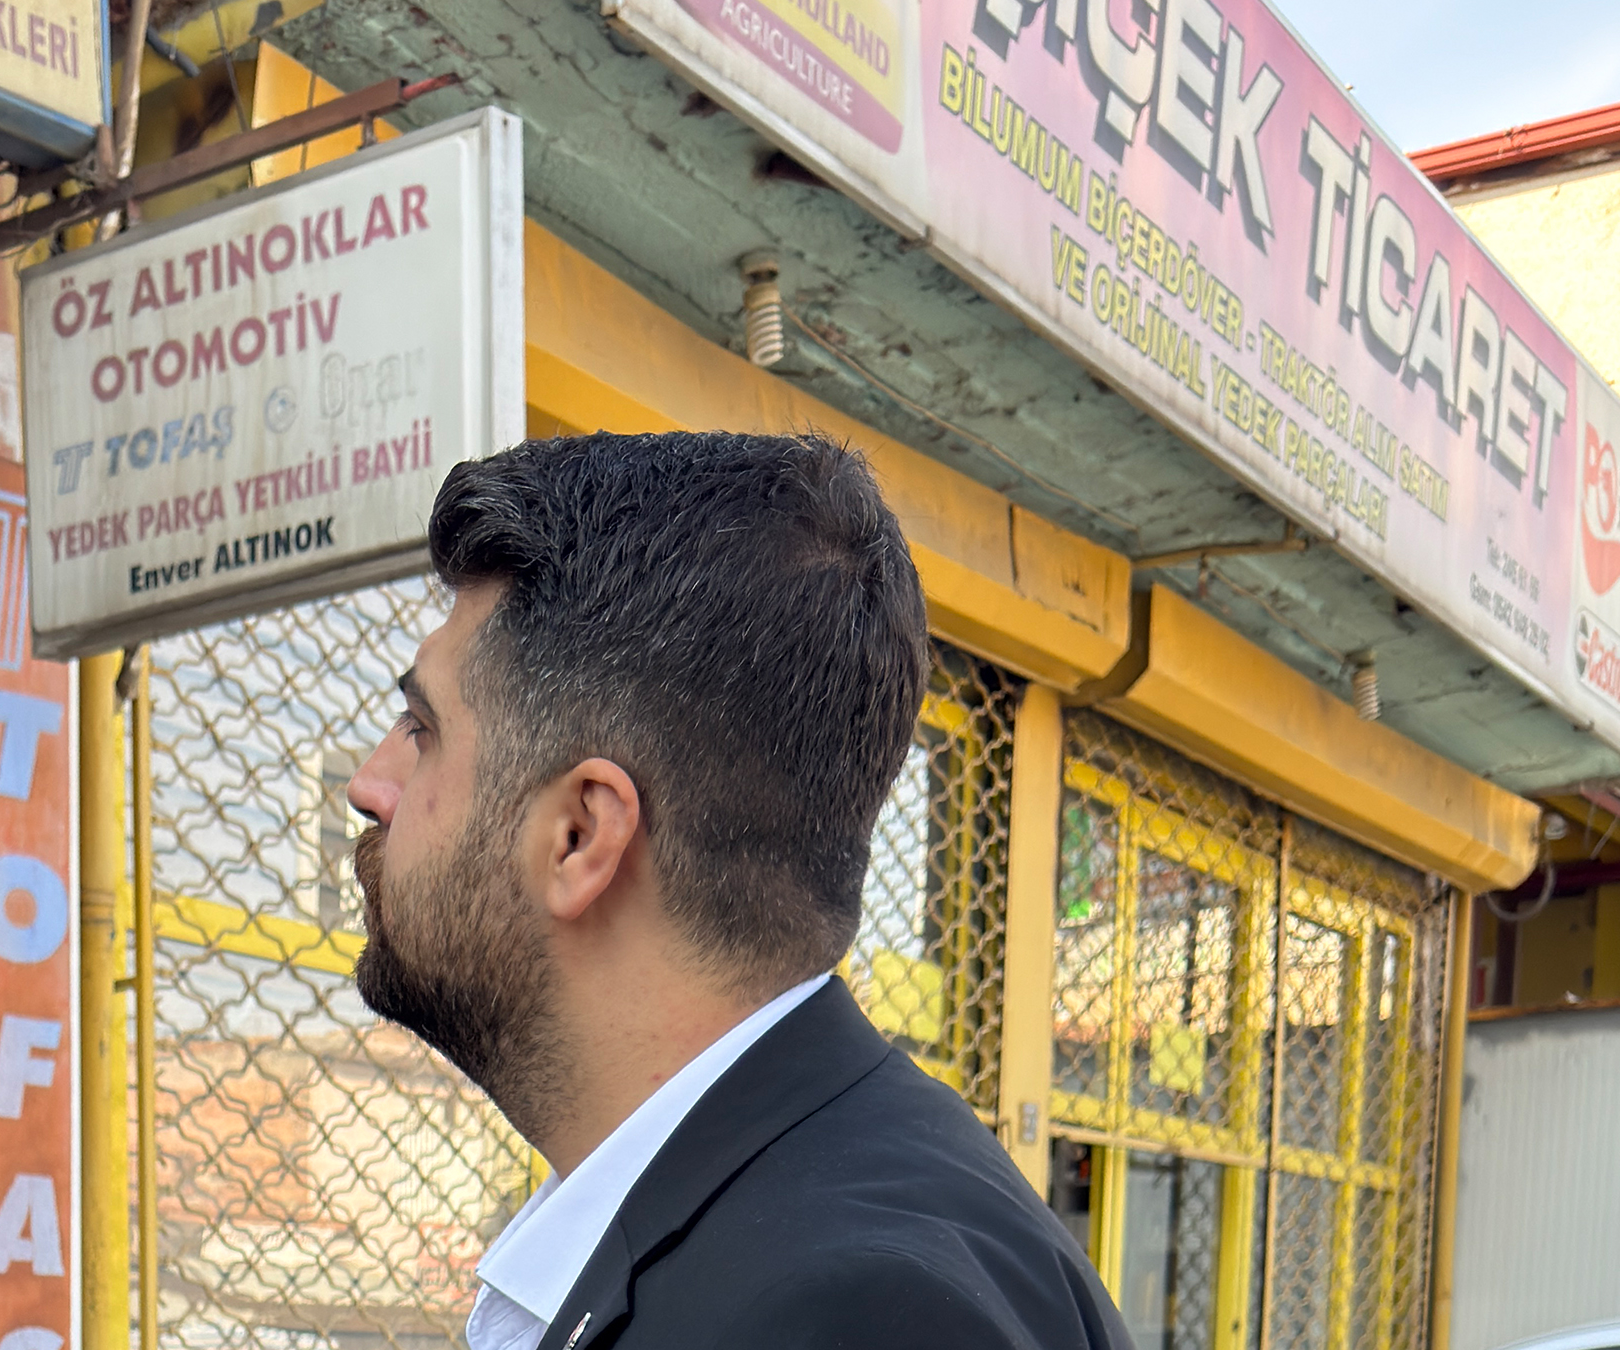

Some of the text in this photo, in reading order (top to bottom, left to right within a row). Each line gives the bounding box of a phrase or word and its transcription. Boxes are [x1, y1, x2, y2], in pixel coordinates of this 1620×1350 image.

[720, 1, 854, 115] AGRICULTURE
[52, 184, 430, 339] ÖZ ALTINOKLAR
[939, 41, 1083, 217] BİLUMUM
[1086, 169, 1244, 351] BİÇERDÖVER
[1259, 318, 1350, 442] TRAKTÖR
[1351, 405, 1399, 481] ALIM
[1399, 442, 1450, 523] SATIM
[1306, 113, 1568, 496] TİCARET
[92, 292, 341, 402] OTOMOTİV
[1050, 222, 1389, 543] VE ORİJİNAL YEDEK PARÇALARI
[47, 417, 433, 564] YEDEK PARÇA YETKİLİ BAYİİ
[105, 405, 235, 477] TOFAŞ
[129, 516, 336, 595] Enver ALTINOK
